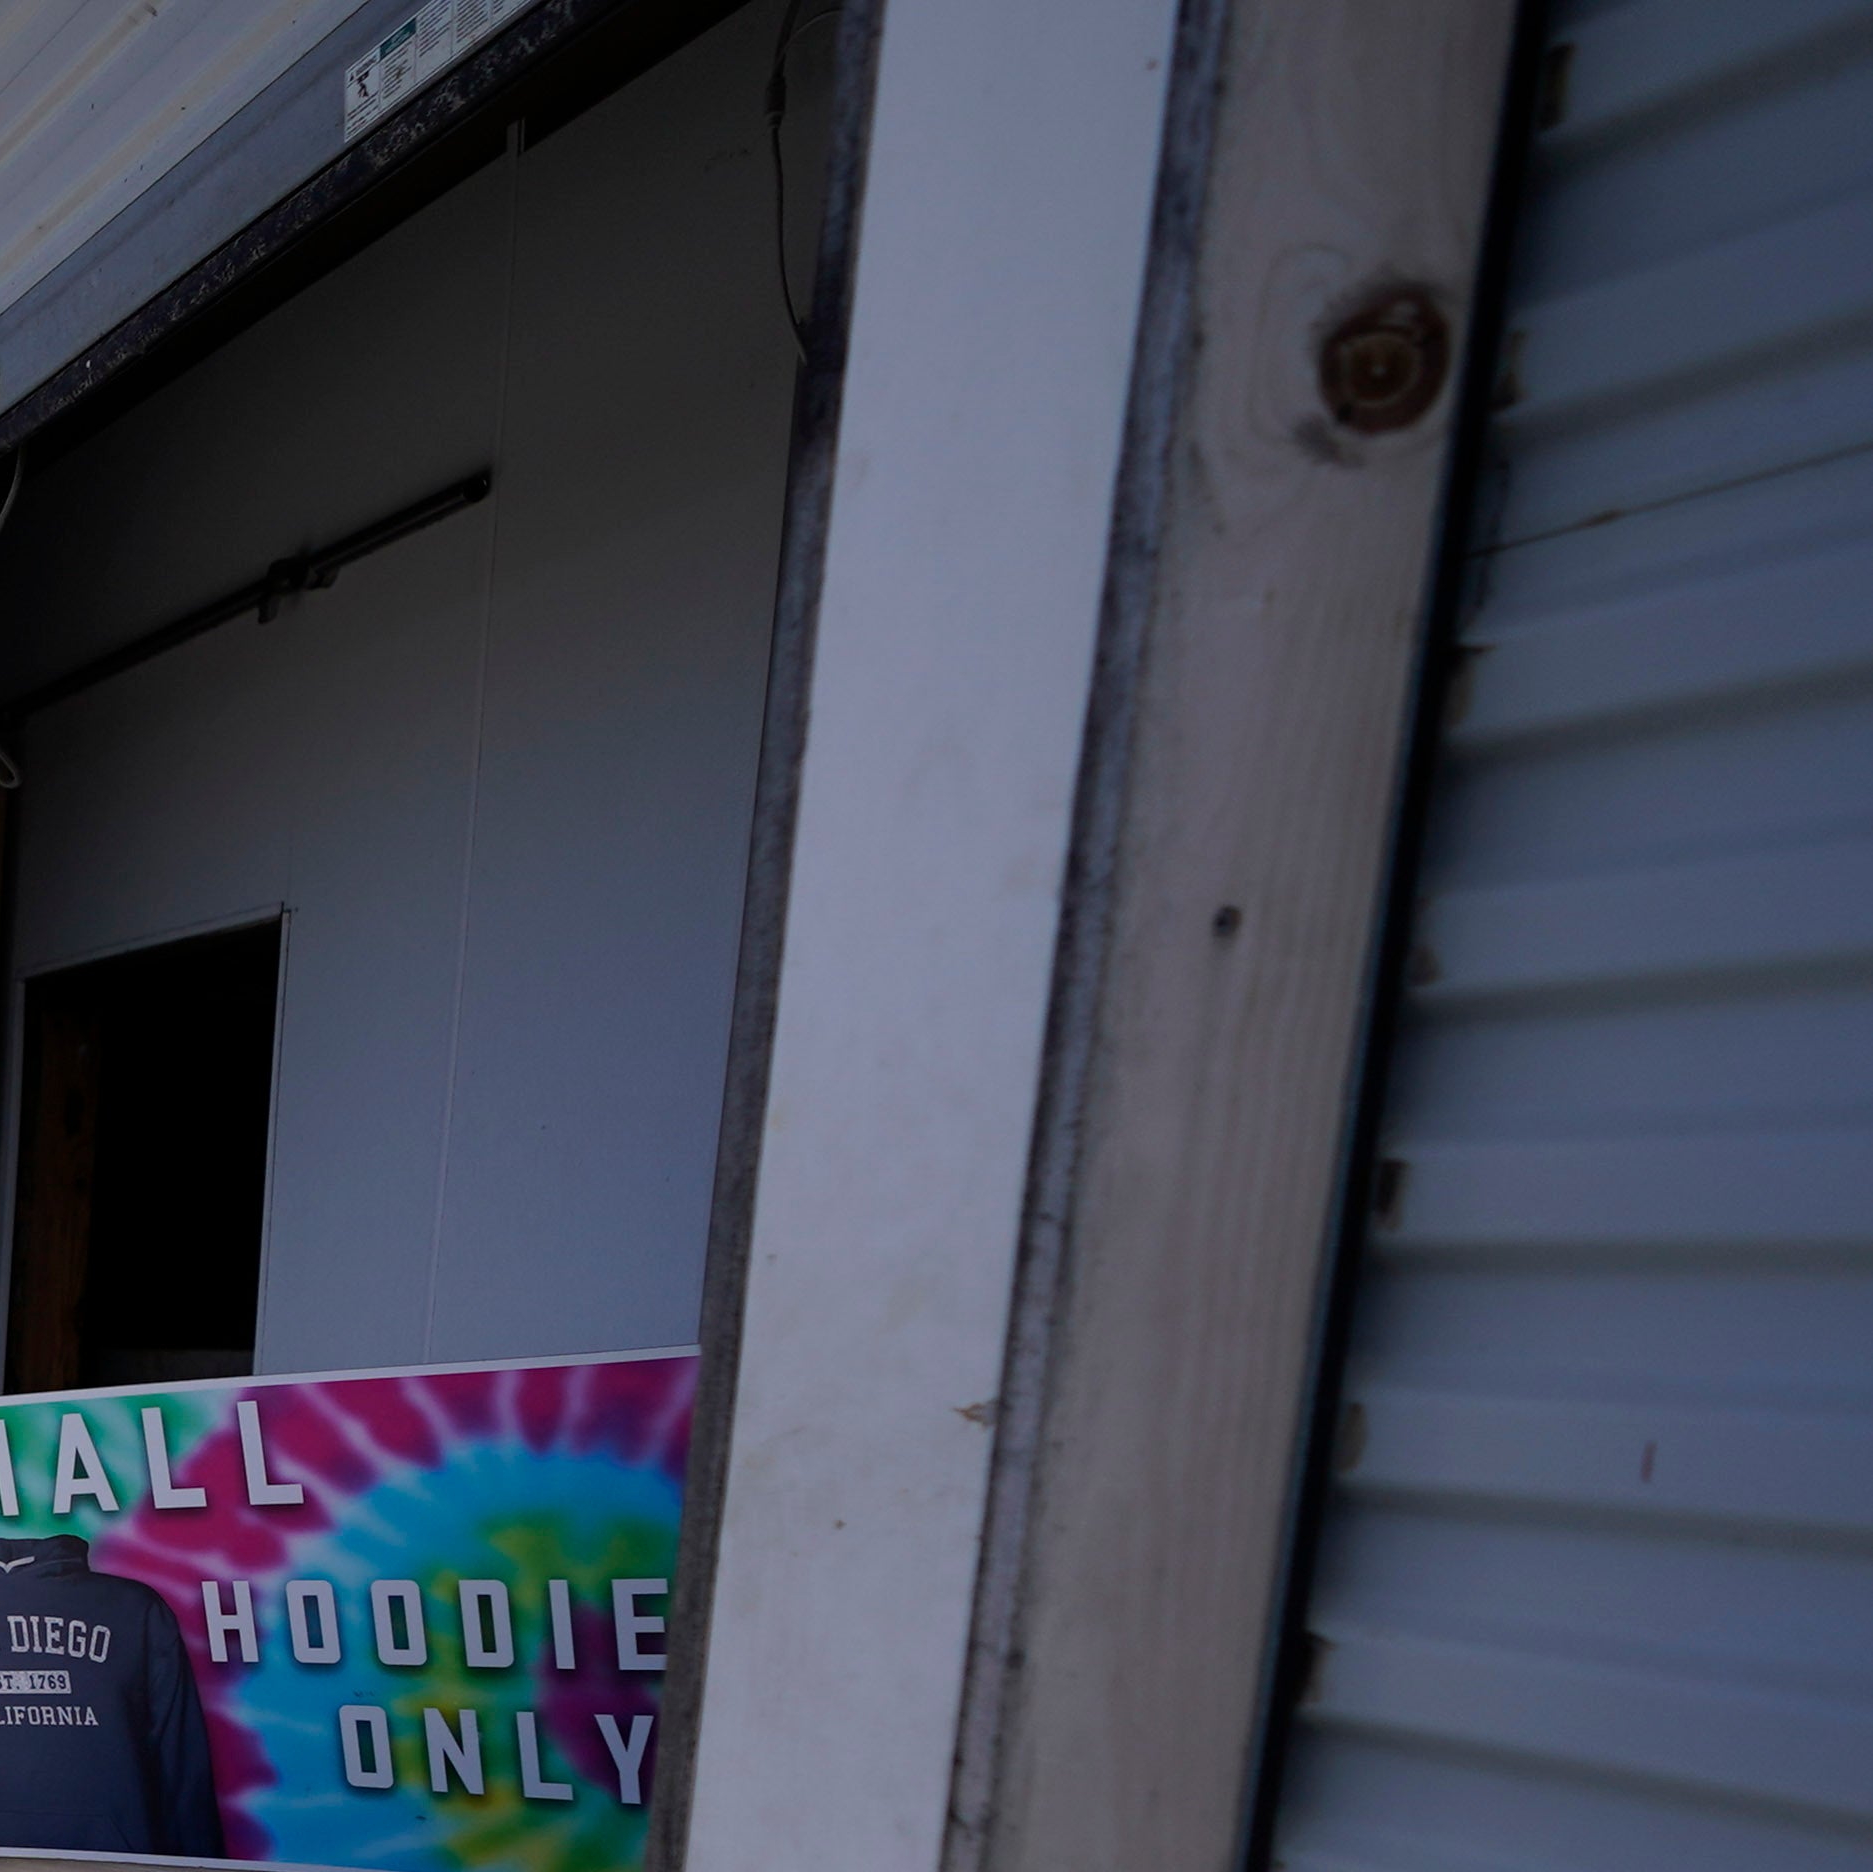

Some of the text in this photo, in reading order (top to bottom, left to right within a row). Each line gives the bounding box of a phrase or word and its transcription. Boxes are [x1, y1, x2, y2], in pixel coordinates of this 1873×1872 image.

[6, 1615, 112, 1664] DIEGO
[201, 1578, 670, 1671] HOODIE
[28, 1673, 68, 1691] 1769
[339, 1704, 654, 1804] ONLY
